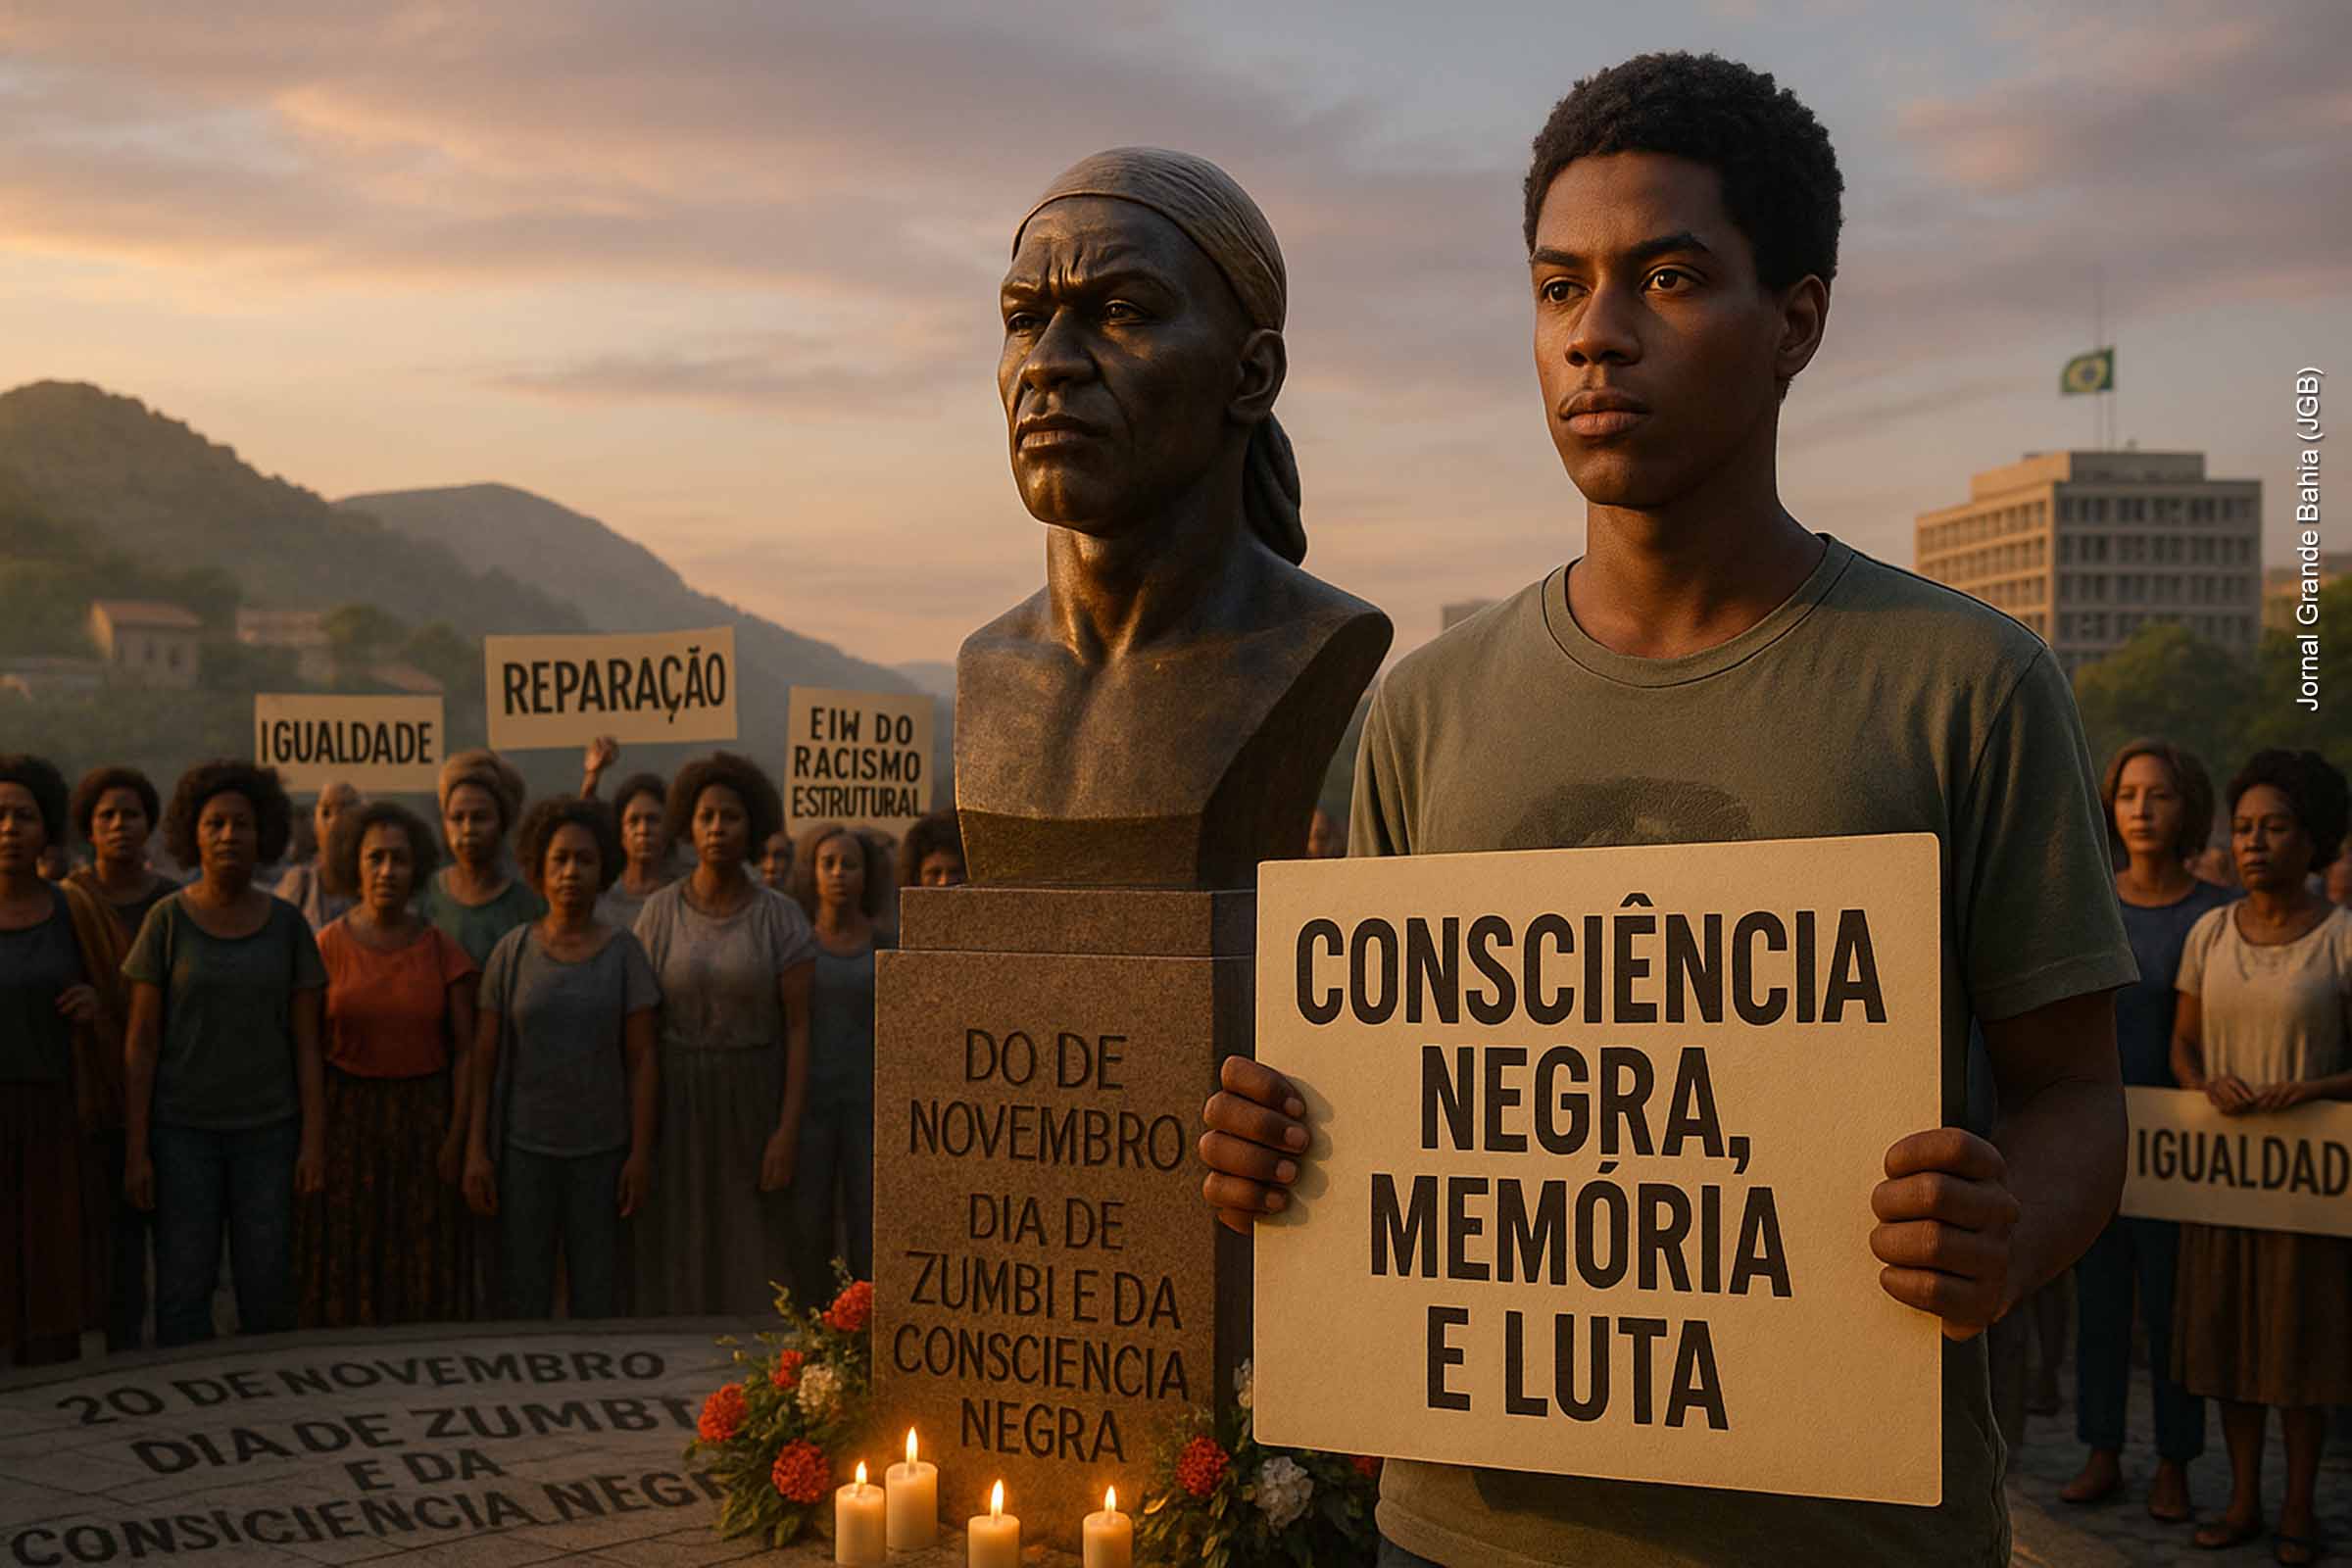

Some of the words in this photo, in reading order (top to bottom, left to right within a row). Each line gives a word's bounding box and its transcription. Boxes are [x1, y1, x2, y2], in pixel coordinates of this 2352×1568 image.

[502, 647, 727, 723] REPARAÇÃO
[260, 719, 434, 766] IGUALDADE
[875, 709, 913, 745] DO
[794, 746, 921, 782] RACISMO
[792, 786, 925, 820] ESTRUTURAL
[1296, 892, 1887, 1026] CONSCIÊNCIA
[964, 1029, 1037, 1086] DO
[1056, 1033, 1128, 1091] DE
[908, 1099, 1187, 1171] NOVEMBRO
[1421, 1045, 1751, 1174] NEGRA,
[2137, 1128, 2351, 1197] IGUALDAD
[969, 1193, 1047, 1248] DIA
[1064, 1198, 1125, 1250] DE
[1371, 1160, 1792, 1298] MEMÓRIA
[906, 1250, 1054, 1319] ZUMBI
[1074, 1268, 1099, 1324] E
[1113, 1272, 1183, 1330] DA
[55, 1387, 167, 1426] 20
[171, 1372, 273, 1407] DE
[277, 1351, 666, 1396] NOVEMBRO
[893, 1324, 1189, 1401] CONSCIENCIA
[1427, 1305, 1471, 1412] E
[1504, 1309, 1729, 1430] LUTA
[130, 1427, 298, 1475] DIA
[293, 1413, 407, 1454] DE
[960, 1397, 1127, 1463] NEGRA
[343, 1458, 399, 1493] E
[403, 1447, 509, 1485] DA
[10, 1491, 535, 1568] CONSICIENCIA
